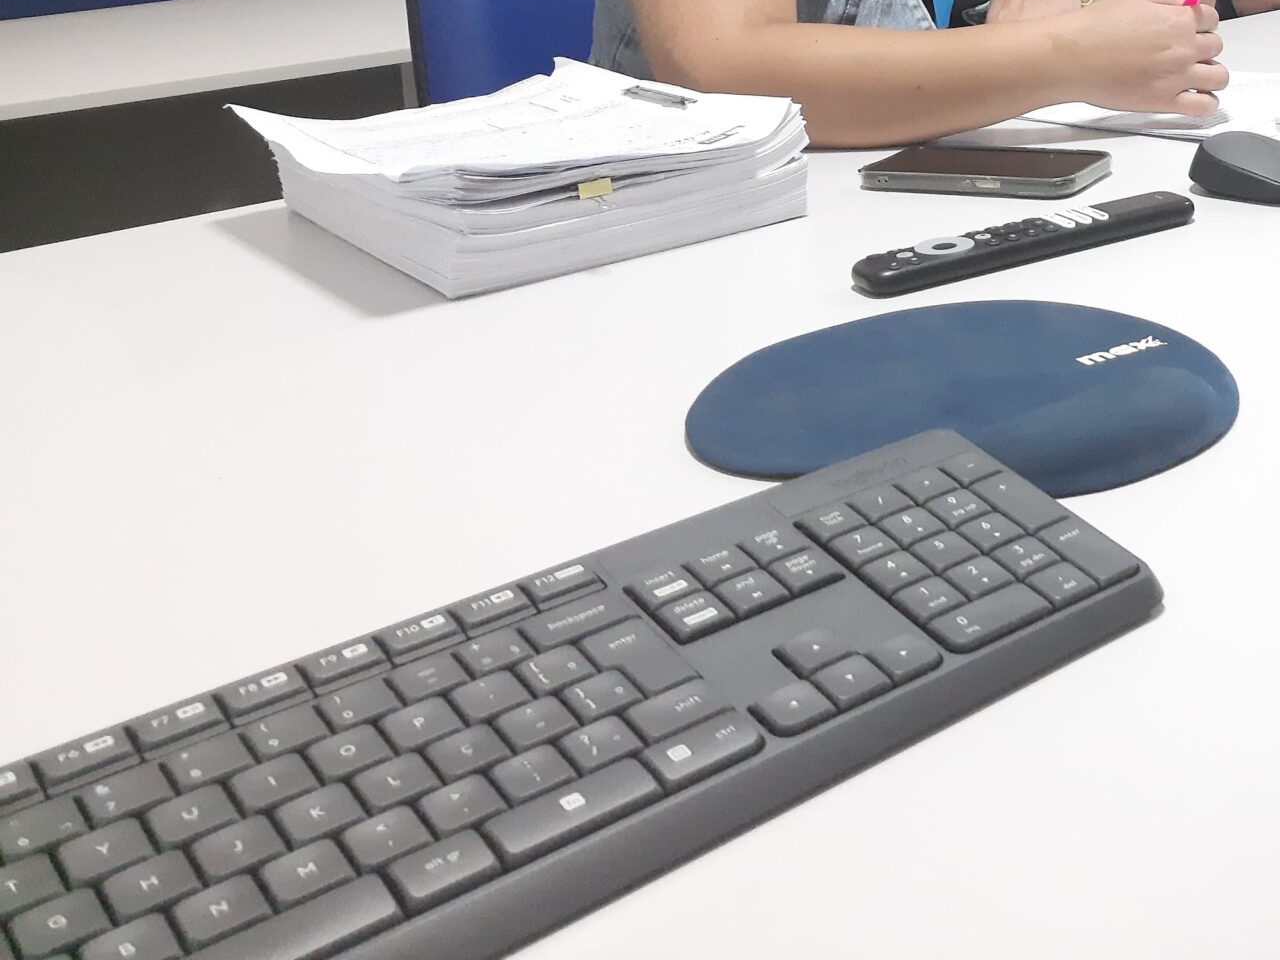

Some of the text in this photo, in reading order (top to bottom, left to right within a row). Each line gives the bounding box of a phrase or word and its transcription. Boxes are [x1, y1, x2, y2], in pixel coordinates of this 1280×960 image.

[396, 625, 420, 639] F10
[413, 716, 425, 730] P
[339, 745, 356, 757] O
[386, 776, 401, 787] L
[181, 807, 199, 821] U
[309, 806, 326, 820] K
[95, 842, 110, 855] Y
[296, 861, 319, 880] M
[424, 857, 444, 871] alt
[4, 879, 18, 894] T
[208, 900, 229, 918] N
